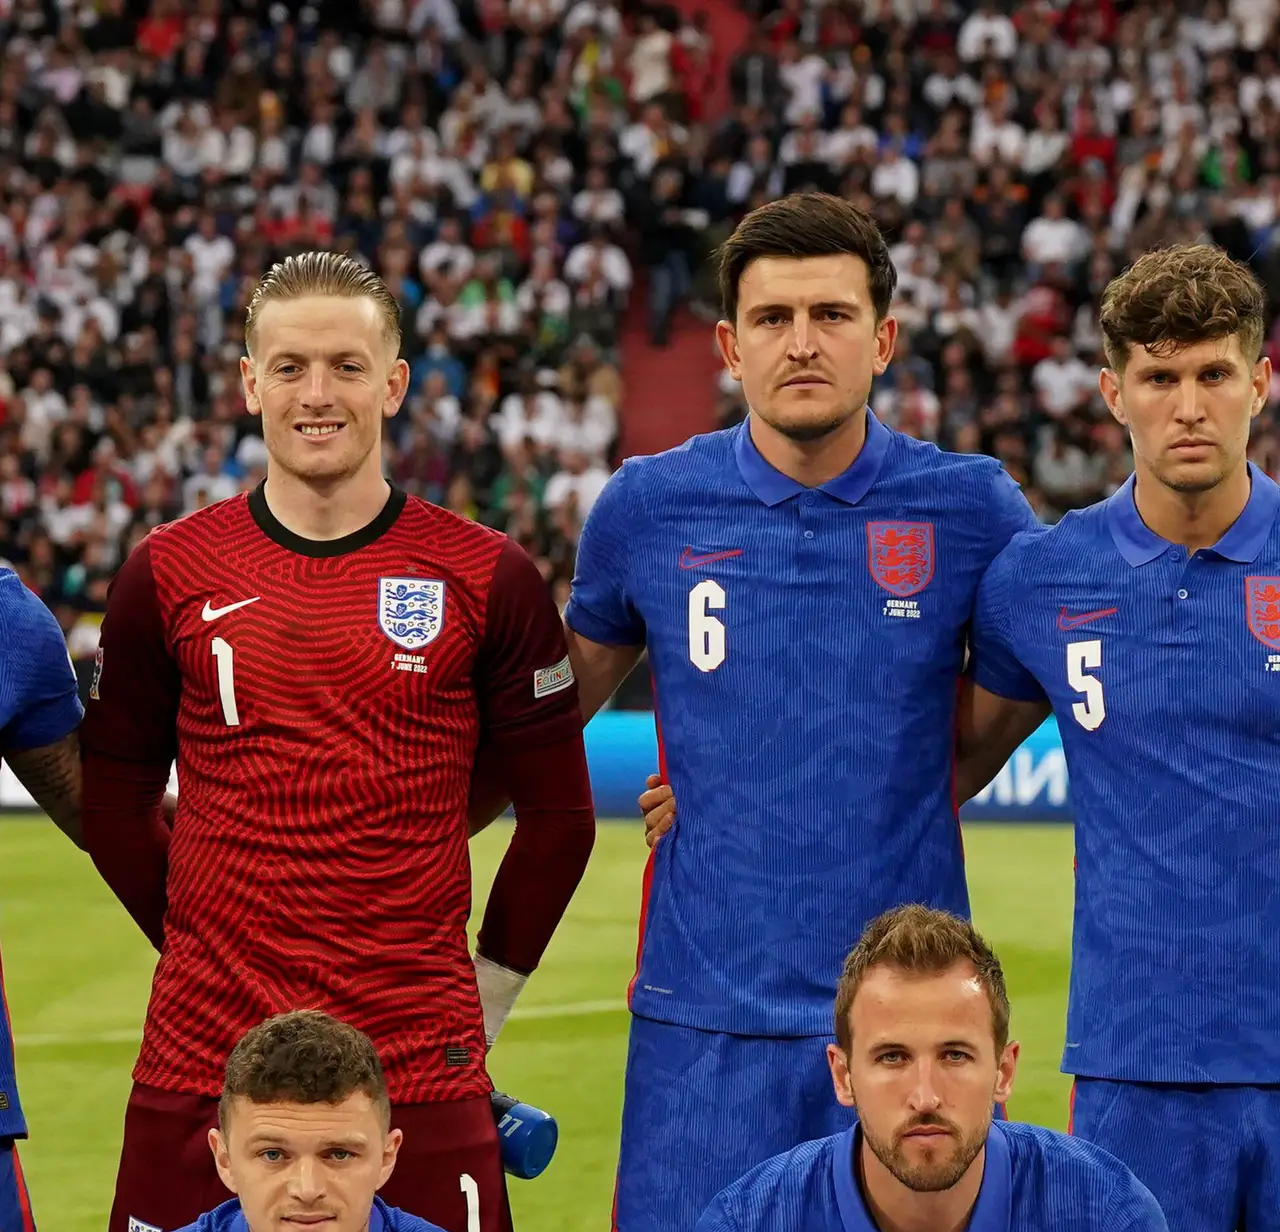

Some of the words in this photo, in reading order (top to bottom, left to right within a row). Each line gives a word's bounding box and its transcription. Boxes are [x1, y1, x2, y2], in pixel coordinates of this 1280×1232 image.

[886, 599, 918, 609] GERMANY
[888, 608, 905, 617] JUNE
[688, 580, 725, 672] 6
[394, 653, 426, 664] GERMANY
[396, 662, 413, 671] JUNE
[211, 637, 239, 726] 1
[1066, 640, 1106, 731] 5
